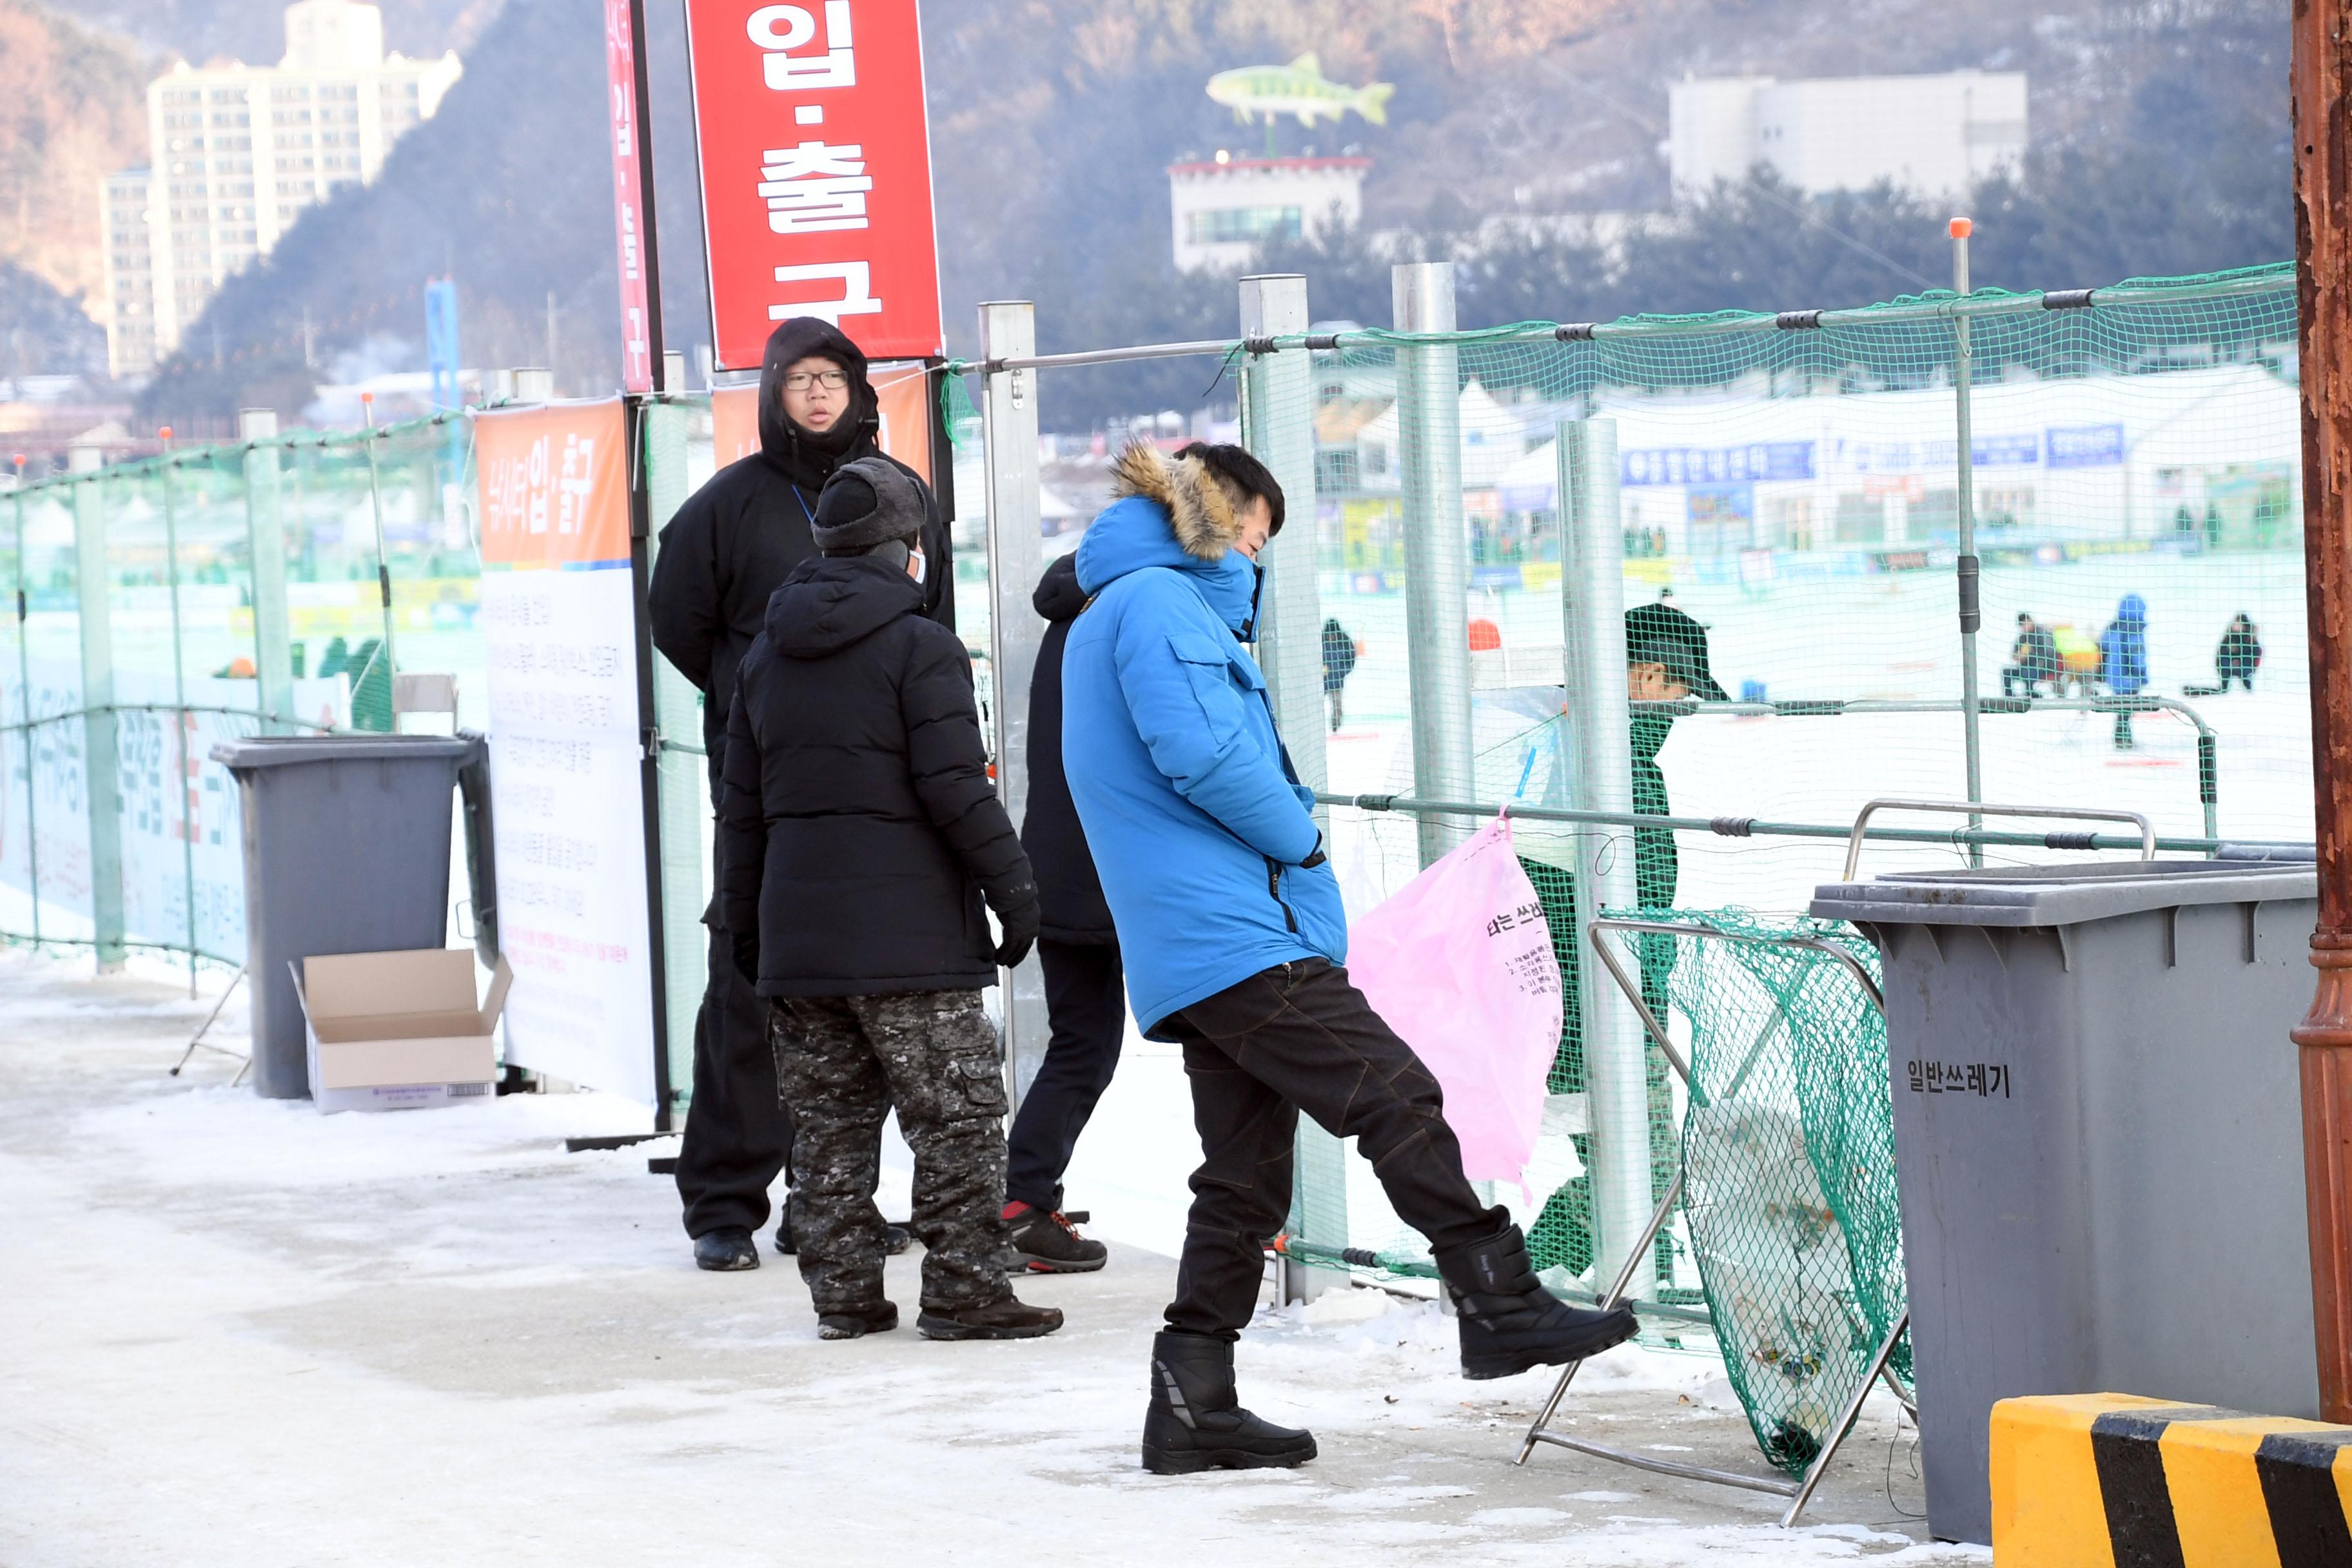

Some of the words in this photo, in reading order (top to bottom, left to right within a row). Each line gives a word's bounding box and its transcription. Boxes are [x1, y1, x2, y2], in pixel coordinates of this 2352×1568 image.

[746, 0, 882, 329] 입·출구
[1487, 914, 1515, 937] 타는
[1908, 1060, 2010, 1099] 일반쓰레기
